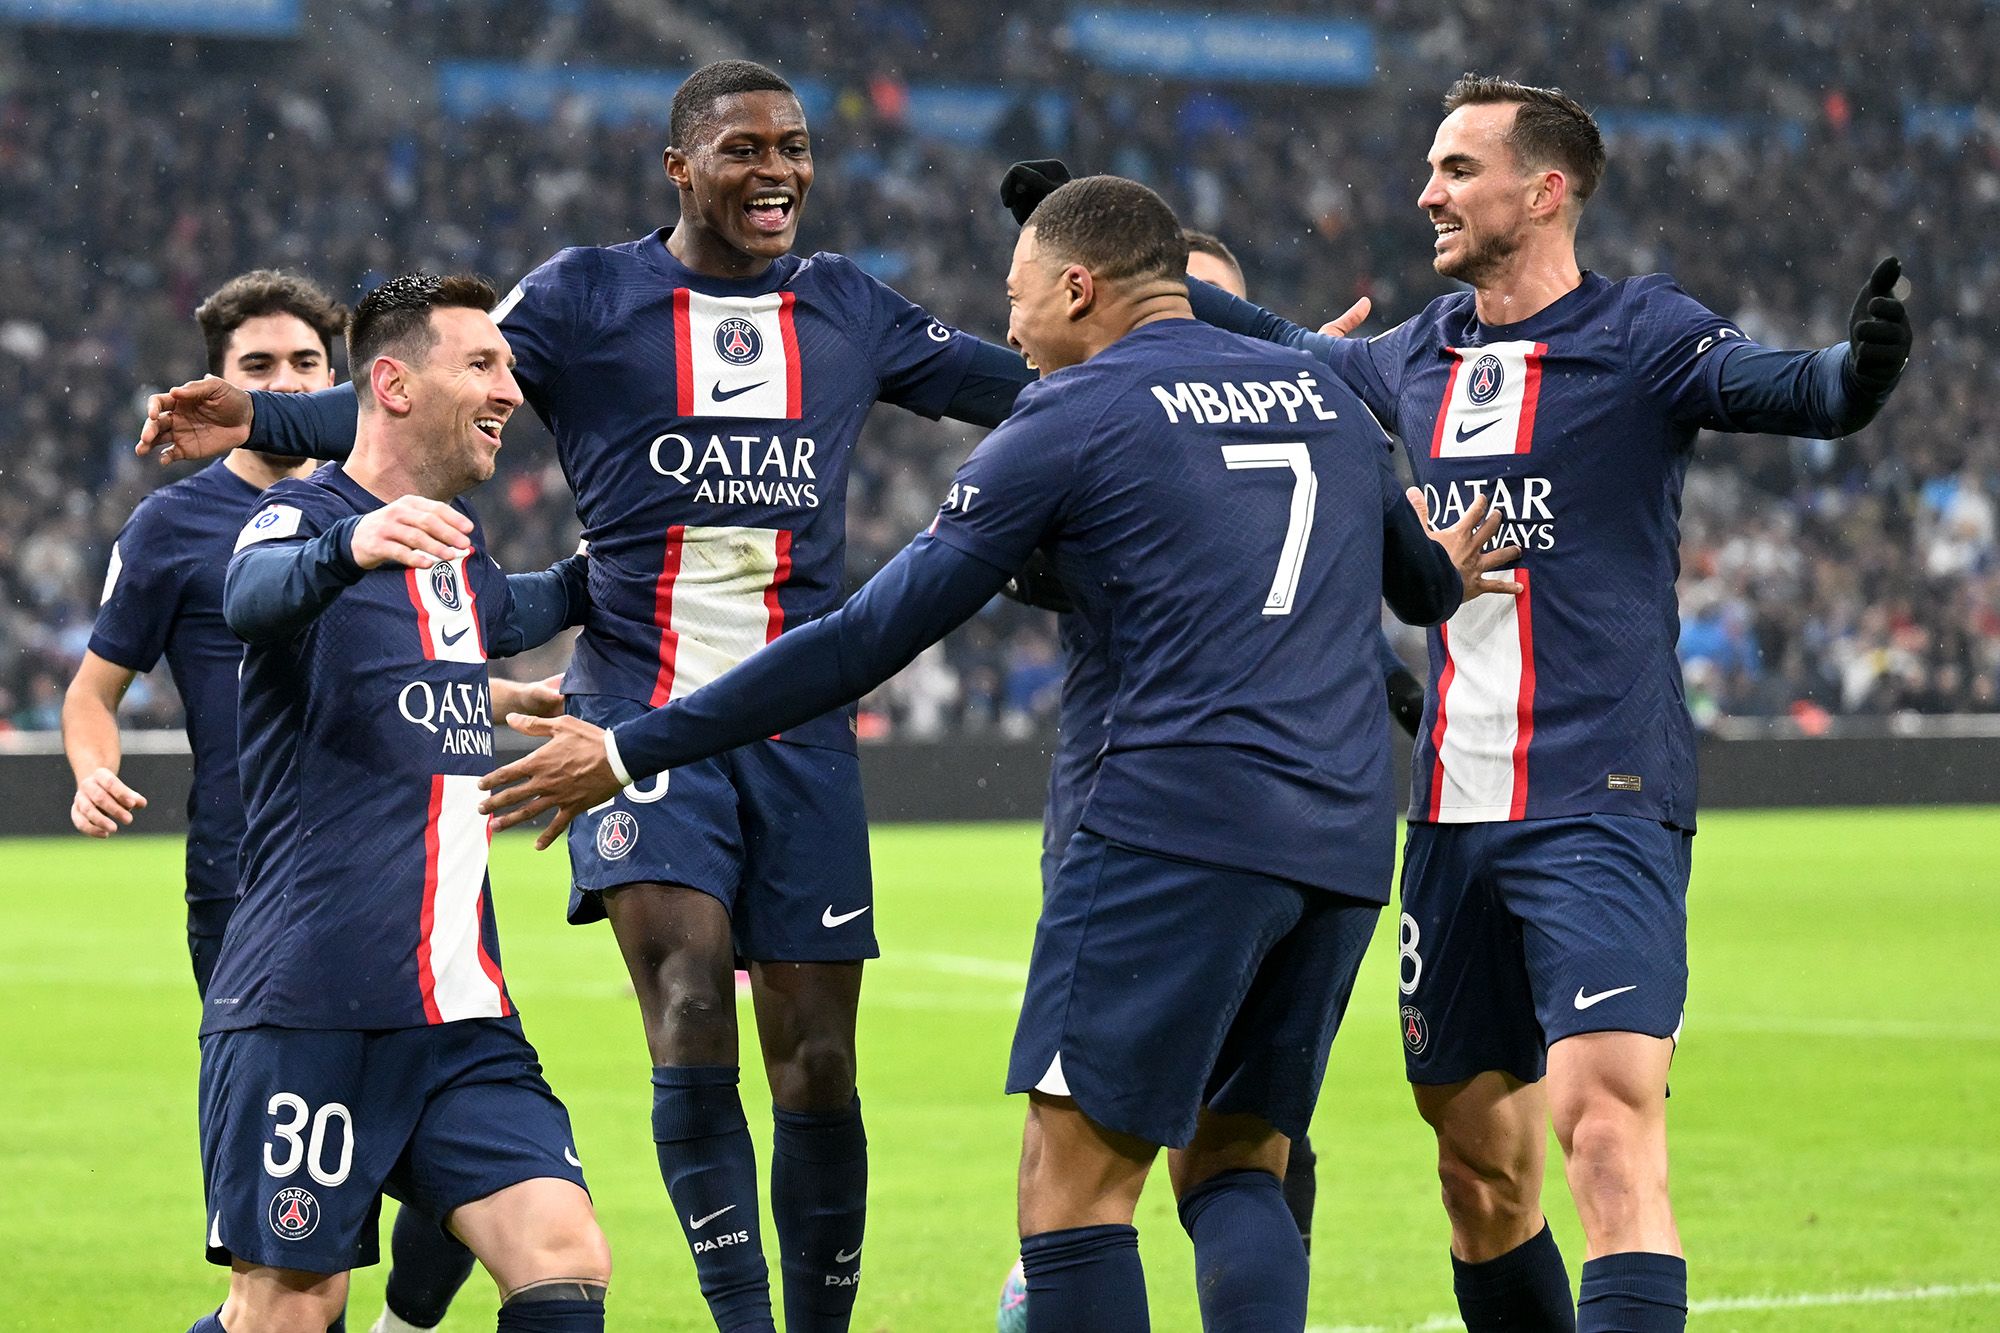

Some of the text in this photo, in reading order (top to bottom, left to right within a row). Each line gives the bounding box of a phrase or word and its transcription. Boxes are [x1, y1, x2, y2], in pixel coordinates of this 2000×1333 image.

[720, 321, 752, 334] PARIS
[1476, 358, 1498, 371] PARIS
[1150, 370, 1338, 424] MBAPPÉ
[649, 433, 817, 485] QATAR
[693, 478, 819, 508] AIRWAYS
[1424, 477, 1555, 531] QATAR
[1220, 442, 1319, 615] 7
[398, 680, 492, 734] QATA
[603, 813, 632, 827] PARIS
[1400, 1007, 1421, 1021] PARIS
[263, 1092, 355, 1188] 30
[279, 1190, 313, 1205] PARIS
[693, 1230, 750, 1254] PARIS
